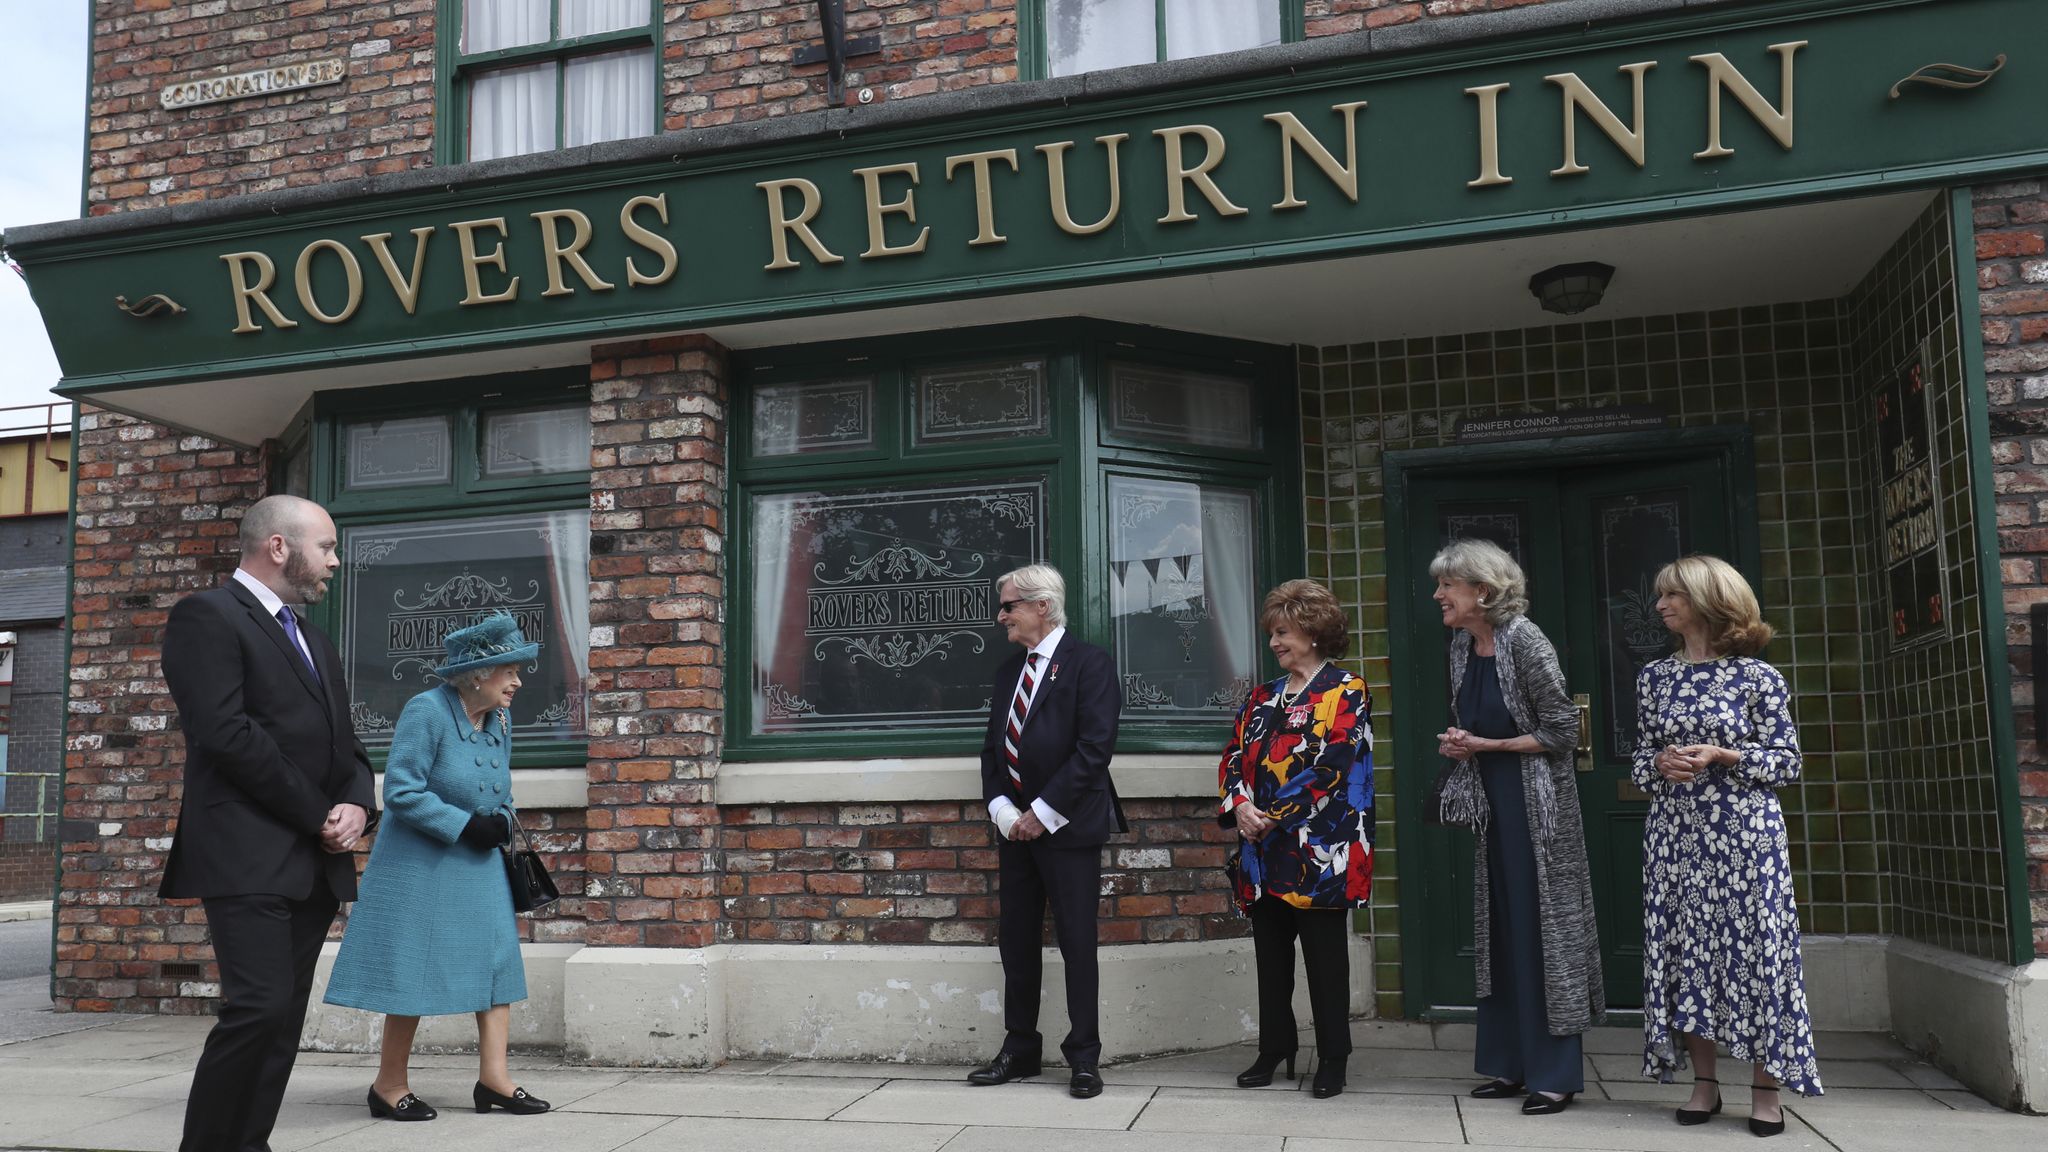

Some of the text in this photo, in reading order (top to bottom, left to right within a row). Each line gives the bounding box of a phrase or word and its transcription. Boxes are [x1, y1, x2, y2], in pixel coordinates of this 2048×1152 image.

[172, 67, 300, 104] CORONATION
[219, 40, 1809, 333] ROVERS RETURN INN
[1462, 420, 1511, 432] JENNIFER
[1514, 416, 1559, 428] CONNOR
[1462, 431, 1501, 440] INTOXICATING
[1502, 429, 1525, 437] LIQUOR
[1539, 423, 1583, 433] CONSUMPTION
[1892, 435, 1914, 472] THE
[1885, 462, 1932, 520] ROVERS
[1887, 506, 1936, 563] RETURN
[808, 585, 991, 629] ROVERS RETURN
